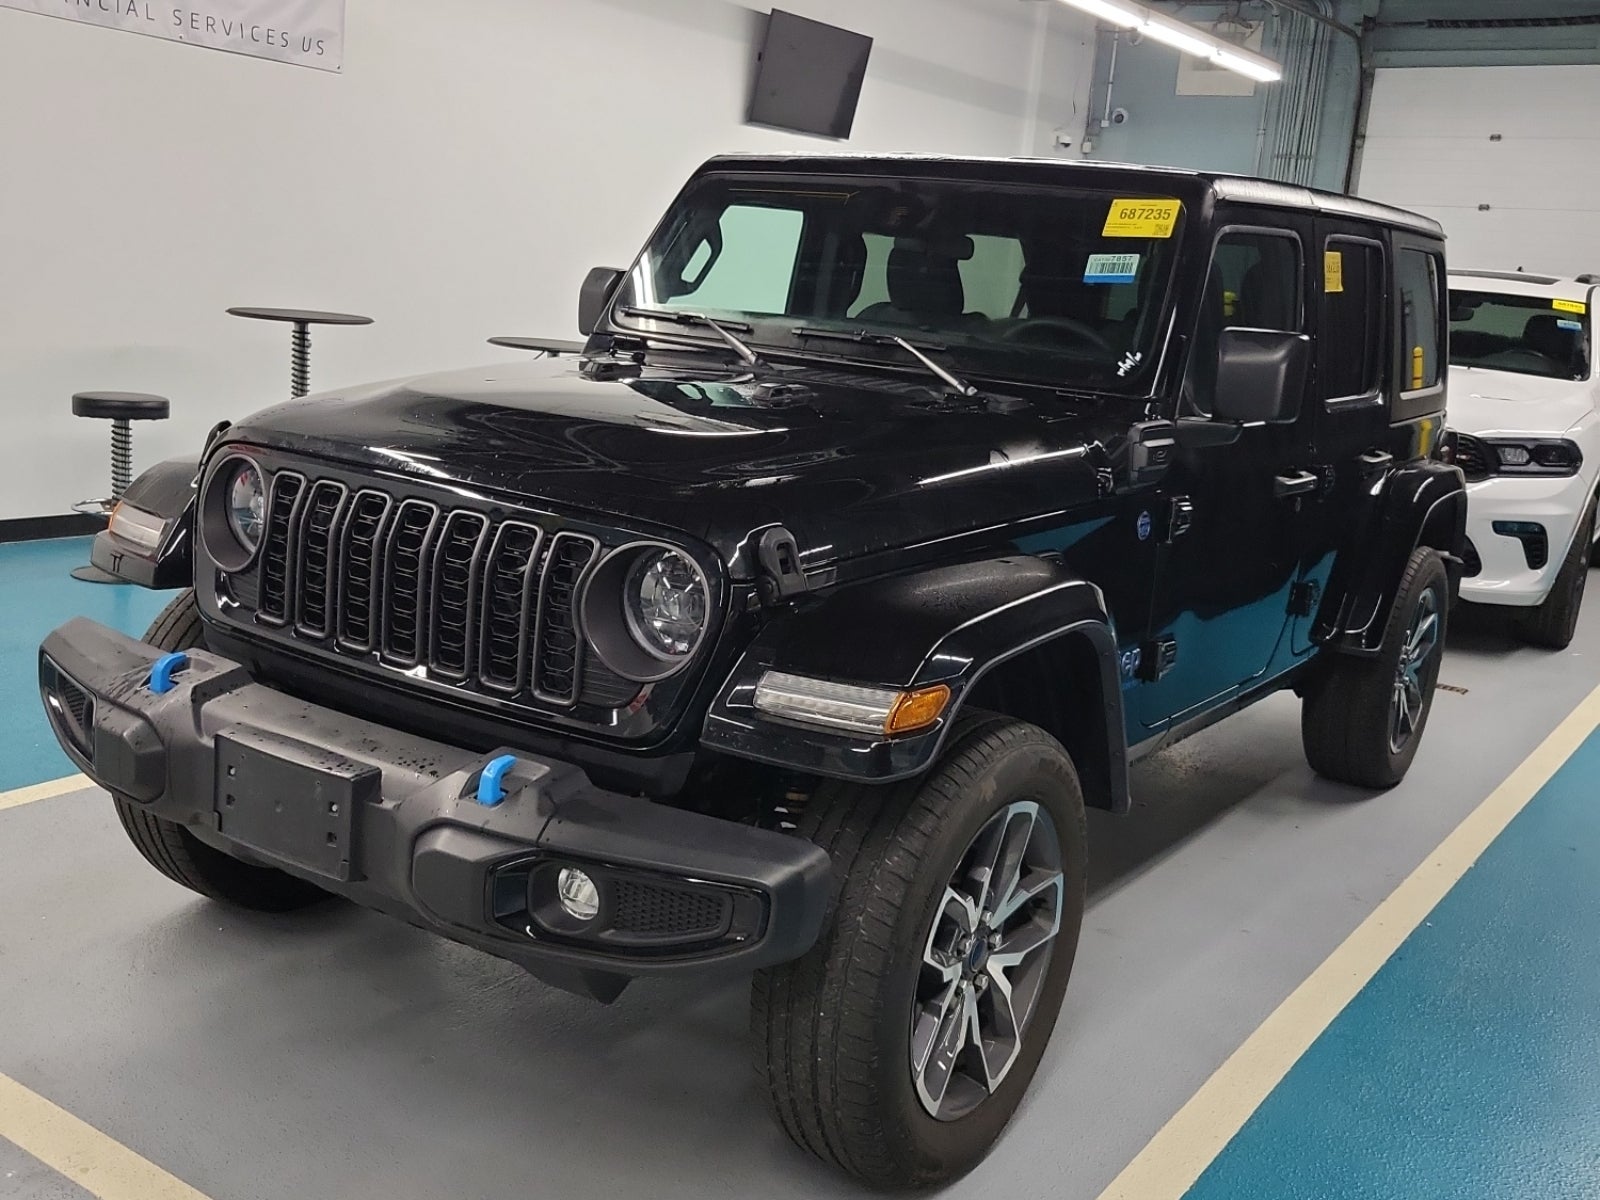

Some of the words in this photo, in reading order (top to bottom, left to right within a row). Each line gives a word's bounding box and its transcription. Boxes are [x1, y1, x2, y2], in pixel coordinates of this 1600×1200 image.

[172, 9, 290, 48] SERVICES
[301, 36, 325, 56] US
[1119, 208, 1172, 220] 687235
